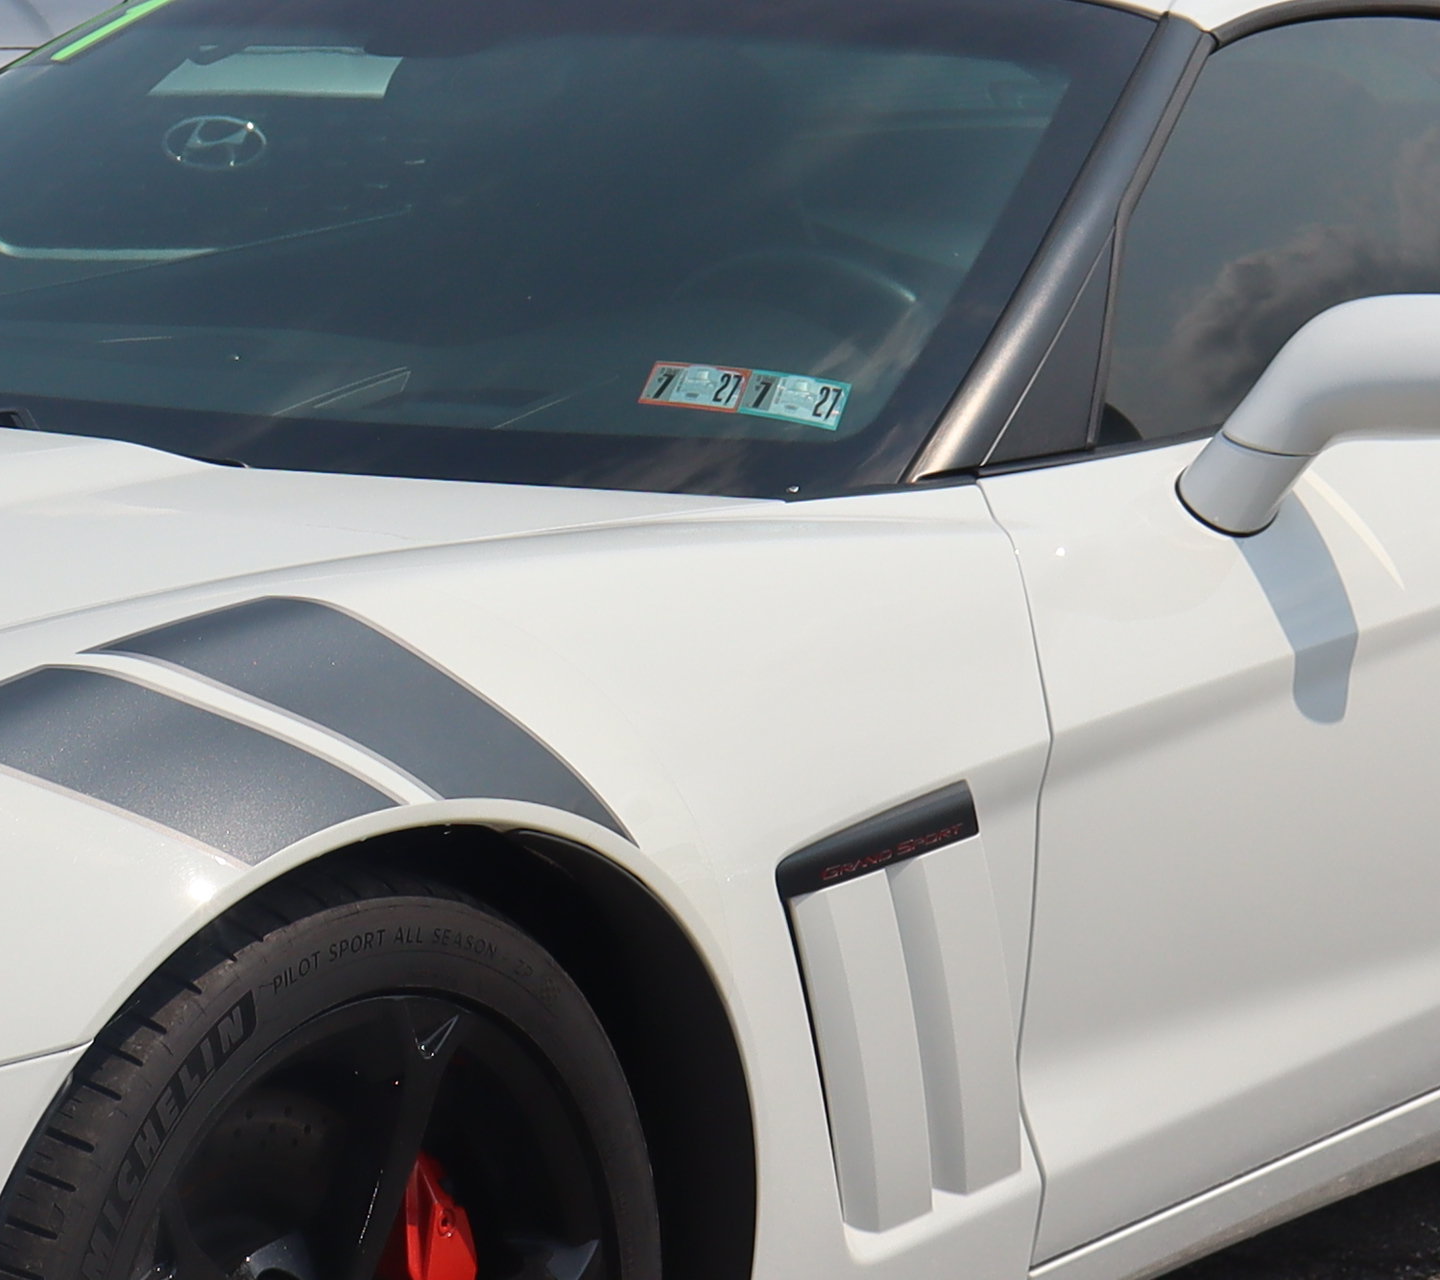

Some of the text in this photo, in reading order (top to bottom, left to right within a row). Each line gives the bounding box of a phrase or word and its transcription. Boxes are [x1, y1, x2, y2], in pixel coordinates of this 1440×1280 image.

[652, 373, 743, 405] 7 27
[752, 381, 843, 420] 7 27
[821, 822, 964, 880] GRAND SPORT
[272, 951, 321, 995] PILOT
[328, 928, 386, 963] SPORT
[394, 926, 424, 944] ALL
[431, 927, 499, 959] SEASON
